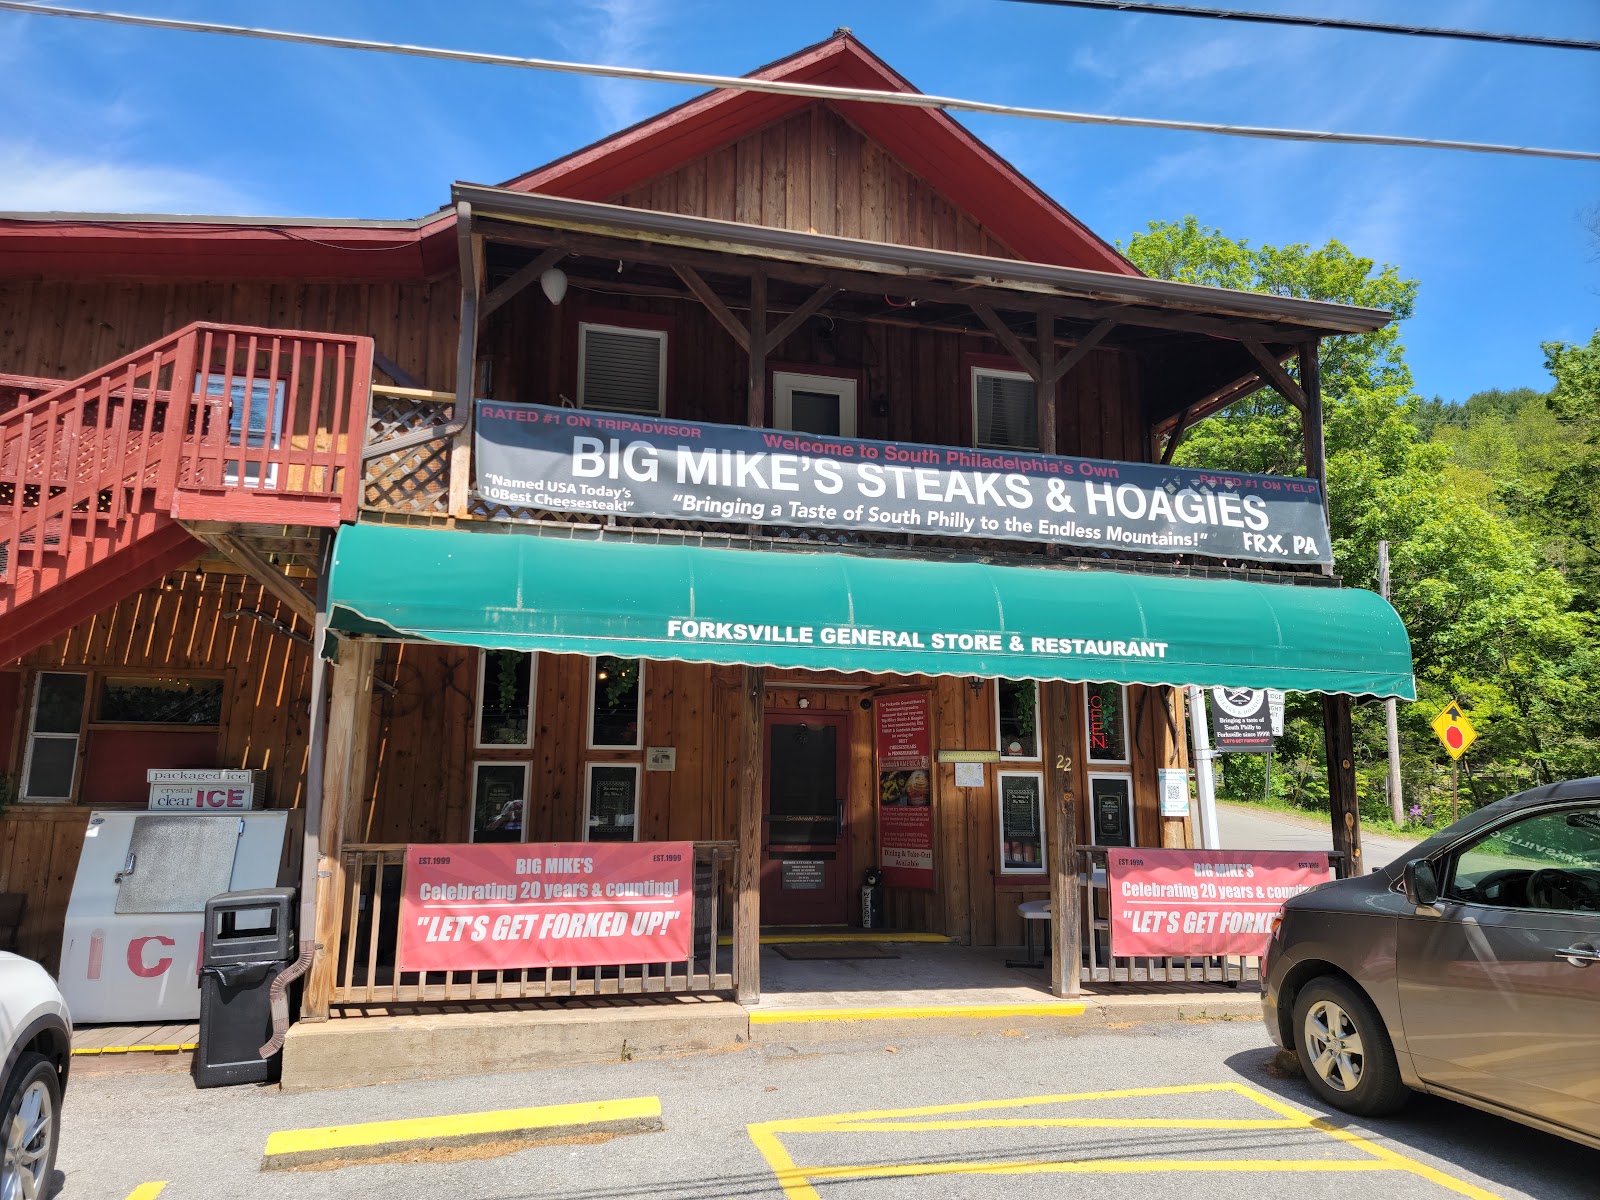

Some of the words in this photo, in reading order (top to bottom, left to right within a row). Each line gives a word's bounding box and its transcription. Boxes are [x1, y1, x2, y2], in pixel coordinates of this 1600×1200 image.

[481, 407, 539, 424] RATED
[543, 414, 561, 425] #1
[566, 415, 591, 428] ON
[596, 418, 701, 438] TRIPADVISOR
[763, 433, 853, 459] Welcome
[858, 444, 879, 460] to
[884, 445, 940, 465] South
[946, 447, 1075, 475] Philadelphia's
[1079, 462, 1119, 478] Own
[547, 480, 577, 494] USA
[579, 484, 632, 500] Today’s
[572, 436, 659, 483] BIG
[676, 446, 843, 495] MIKE’S
[857, 459, 1033, 510] STEAKS
[1046, 477, 1077, 513] &
[1087, 480, 1270, 531] HOAGIES
[1199, 474, 1242, 487] RATED
[1245, 480, 1258, 488] #1
[1262, 481, 1281, 491] ON
[1283, 482, 1316, 493] YELP
[483, 486, 532, 504] 10Best
[672, 494, 766, 520] “Bringing
[771, 506, 783, 518] a
[789, 502, 838, 520] Taste
[843, 504, 865, 521] of
[867, 507, 921, 526] South
[927, 511, 976, 533] Philly
[980, 516, 999, 531] to
[1004, 516, 1033, 533] the
[1038, 519, 1102, 539] Endless
[1243, 531, 1289, 556] FRX,
[1294, 533, 1320, 556] PA
[667, 620, 813, 644] FORKSVILLE
[819, 628, 925, 648] GENERAL
[930, 632, 1002, 652] STORE
[1008, 635, 1025, 652] &
[1030, 636, 1168, 659] RESTAURANT
[1056, 755, 1072, 772] 22
[154, 770, 221, 782] packaged
[226, 771, 246, 781] ice
[157, 795, 193, 807] clear
[161, 787, 193, 795] crystal
[195, 788, 245, 808] ICE
[418, 856, 451, 865] EST.1999
[515, 858, 542, 875] BIG
[545, 857, 593, 875] MIKE'S
[653, 854, 682, 862] EST.1999
[1193, 863, 1214, 878] BIG
[1215, 863, 1254, 879] MIKE'S
[419, 882, 517, 902] Celebrating
[520, 882, 541, 899] 20
[544, 880, 589, 900] years
[591, 882, 603, 897] &
[605, 879, 679, 899] counting!
[1121, 881, 1199, 900] Celebrating
[1200, 884, 1217, 899] 20
[1218, 883, 1254, 900] years
[1256, 886, 1265, 899] &
[1267, 883, 1309, 899] counti
[416, 915, 490, 943] "LET'S
[491, 914, 539, 941] GET
[539, 912, 629, 940] FORKED
[1123, 910, 1180, 934] "LET'S
[1183, 910, 1219, 934] GET
[1219, 911, 1277, 934] FORKE
[87, 928, 204, 980] IC
